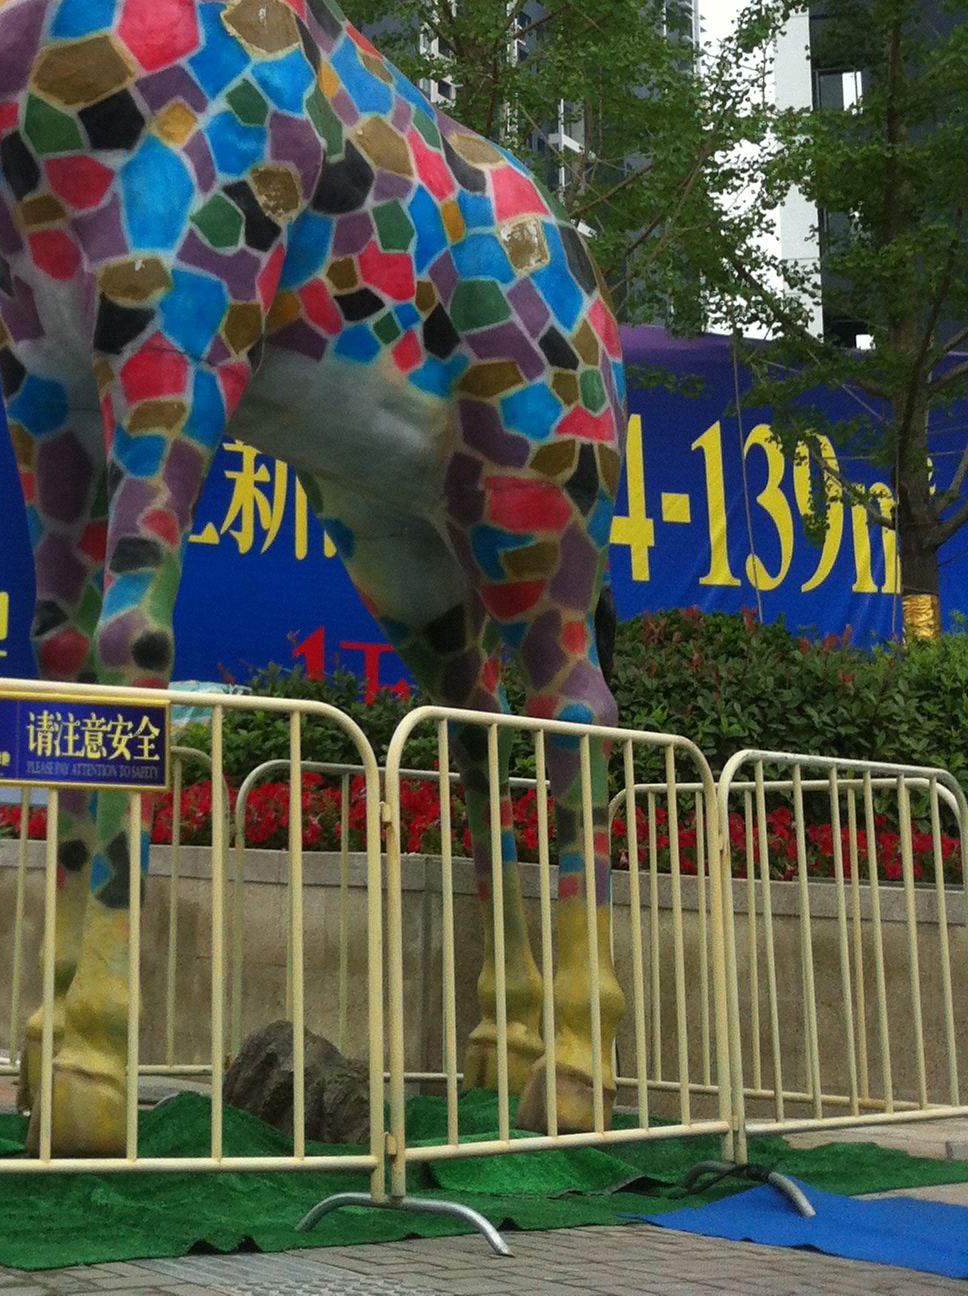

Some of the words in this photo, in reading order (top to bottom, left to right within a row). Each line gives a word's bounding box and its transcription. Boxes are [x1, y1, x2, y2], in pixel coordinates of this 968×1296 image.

[27, 709, 161, 761] 请注意安全
[26, 760, 54, 775] PLEASE
[71, 762, 117, 778] ATTENTION
[118, 764, 130, 778] TO
[131, 765, 159, 780] SAFETY
